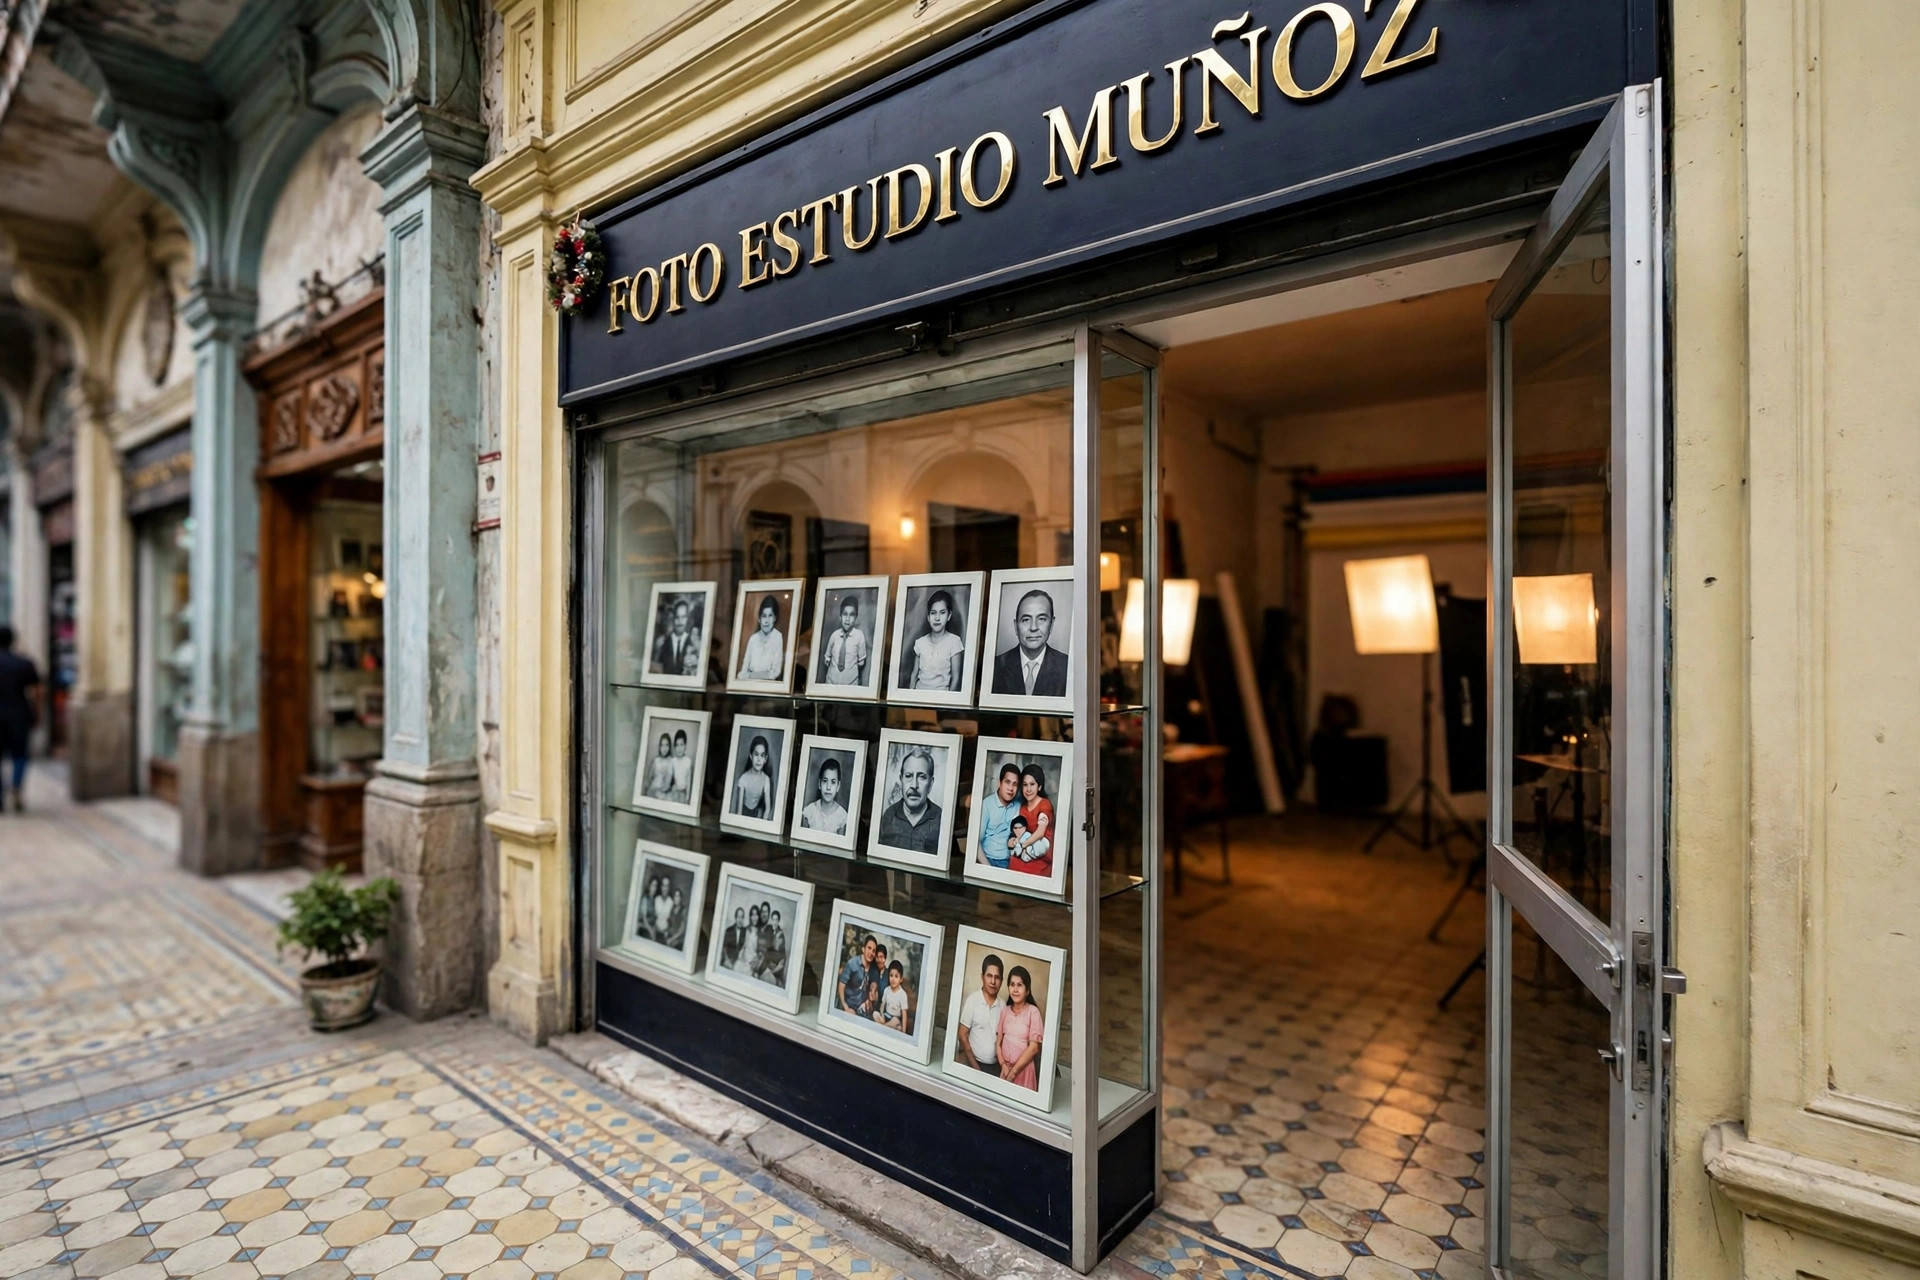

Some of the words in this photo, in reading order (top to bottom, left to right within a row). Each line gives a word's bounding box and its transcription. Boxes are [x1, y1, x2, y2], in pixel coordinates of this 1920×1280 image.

[607, 243, 723, 334] FOTO
[738, 131, 1014, 289] ESTUDIO
[1042, 0, 1439, 188] MUÑOZ
